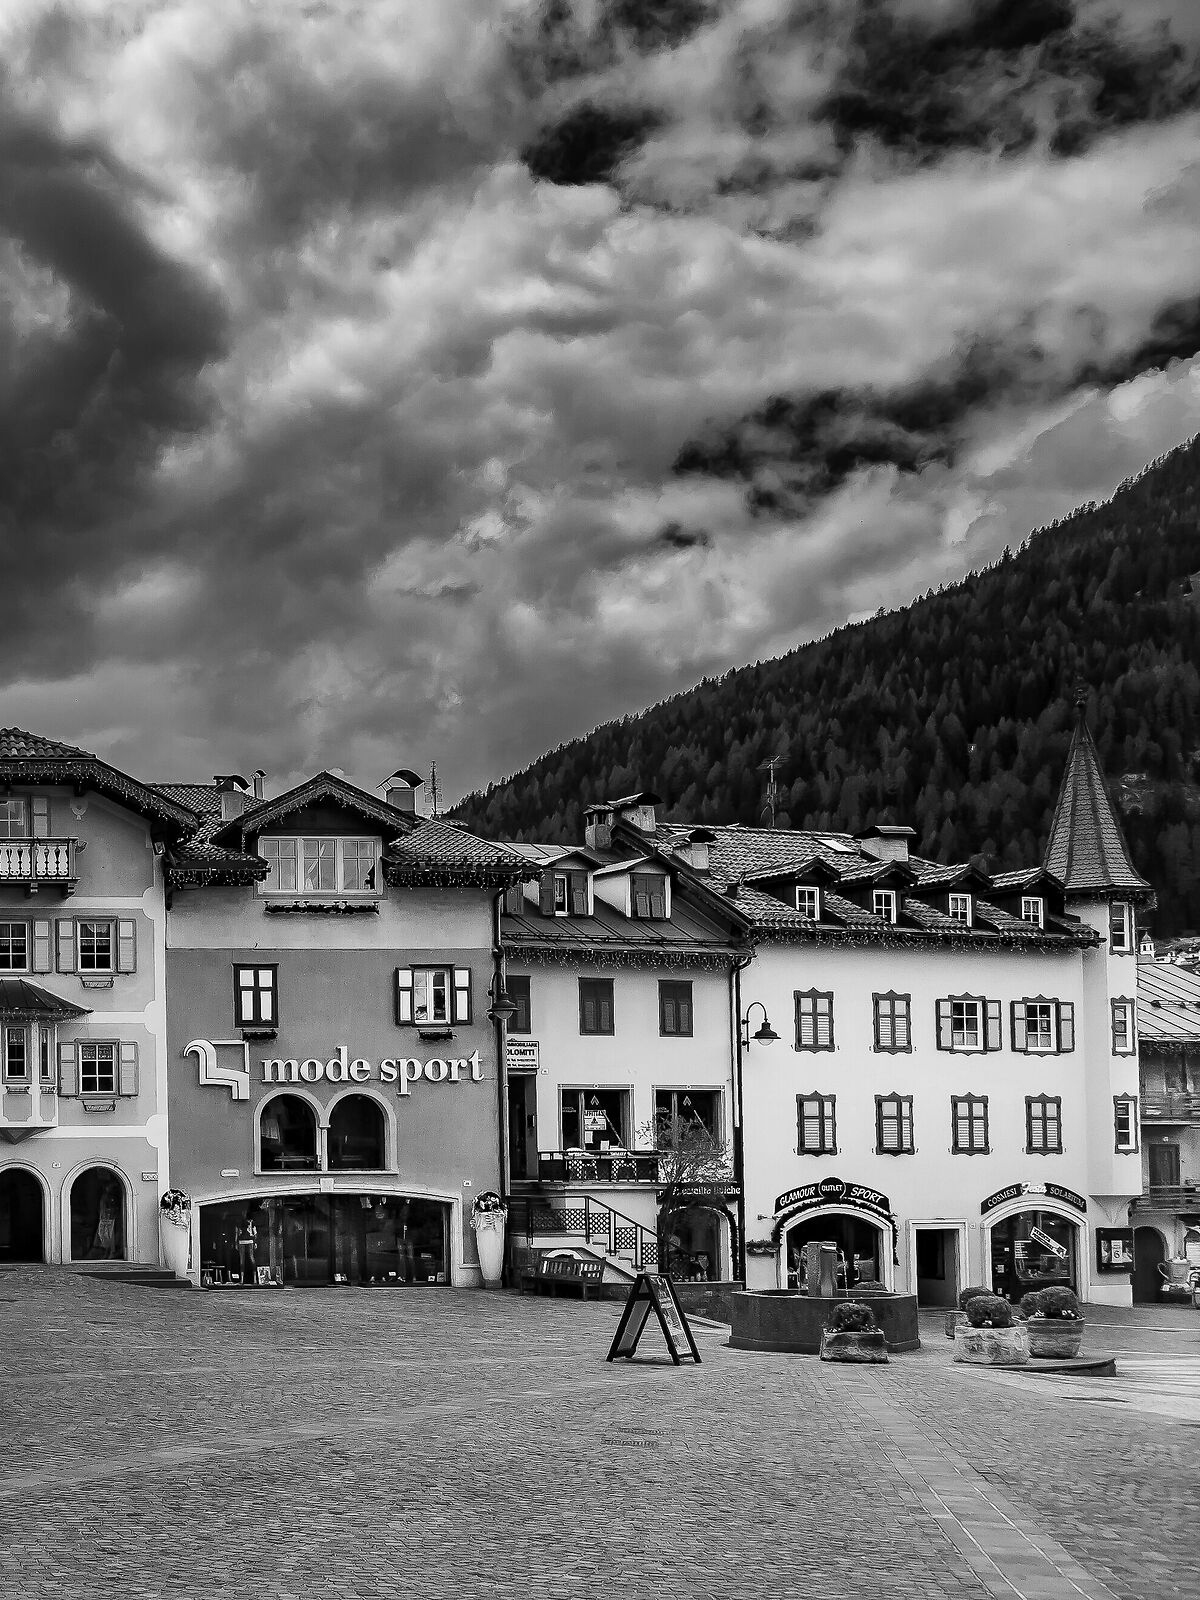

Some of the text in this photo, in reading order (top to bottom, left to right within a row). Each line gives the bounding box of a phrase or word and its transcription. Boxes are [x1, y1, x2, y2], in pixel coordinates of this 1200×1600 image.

[506, 1048, 535, 1056] OLOMITI
[261, 1046, 485, 1095] mode sport
[780, 1184, 885, 1206] GLAMOUR OUTLET SPORT
[987, 1187, 1017, 1207] COSMESI
